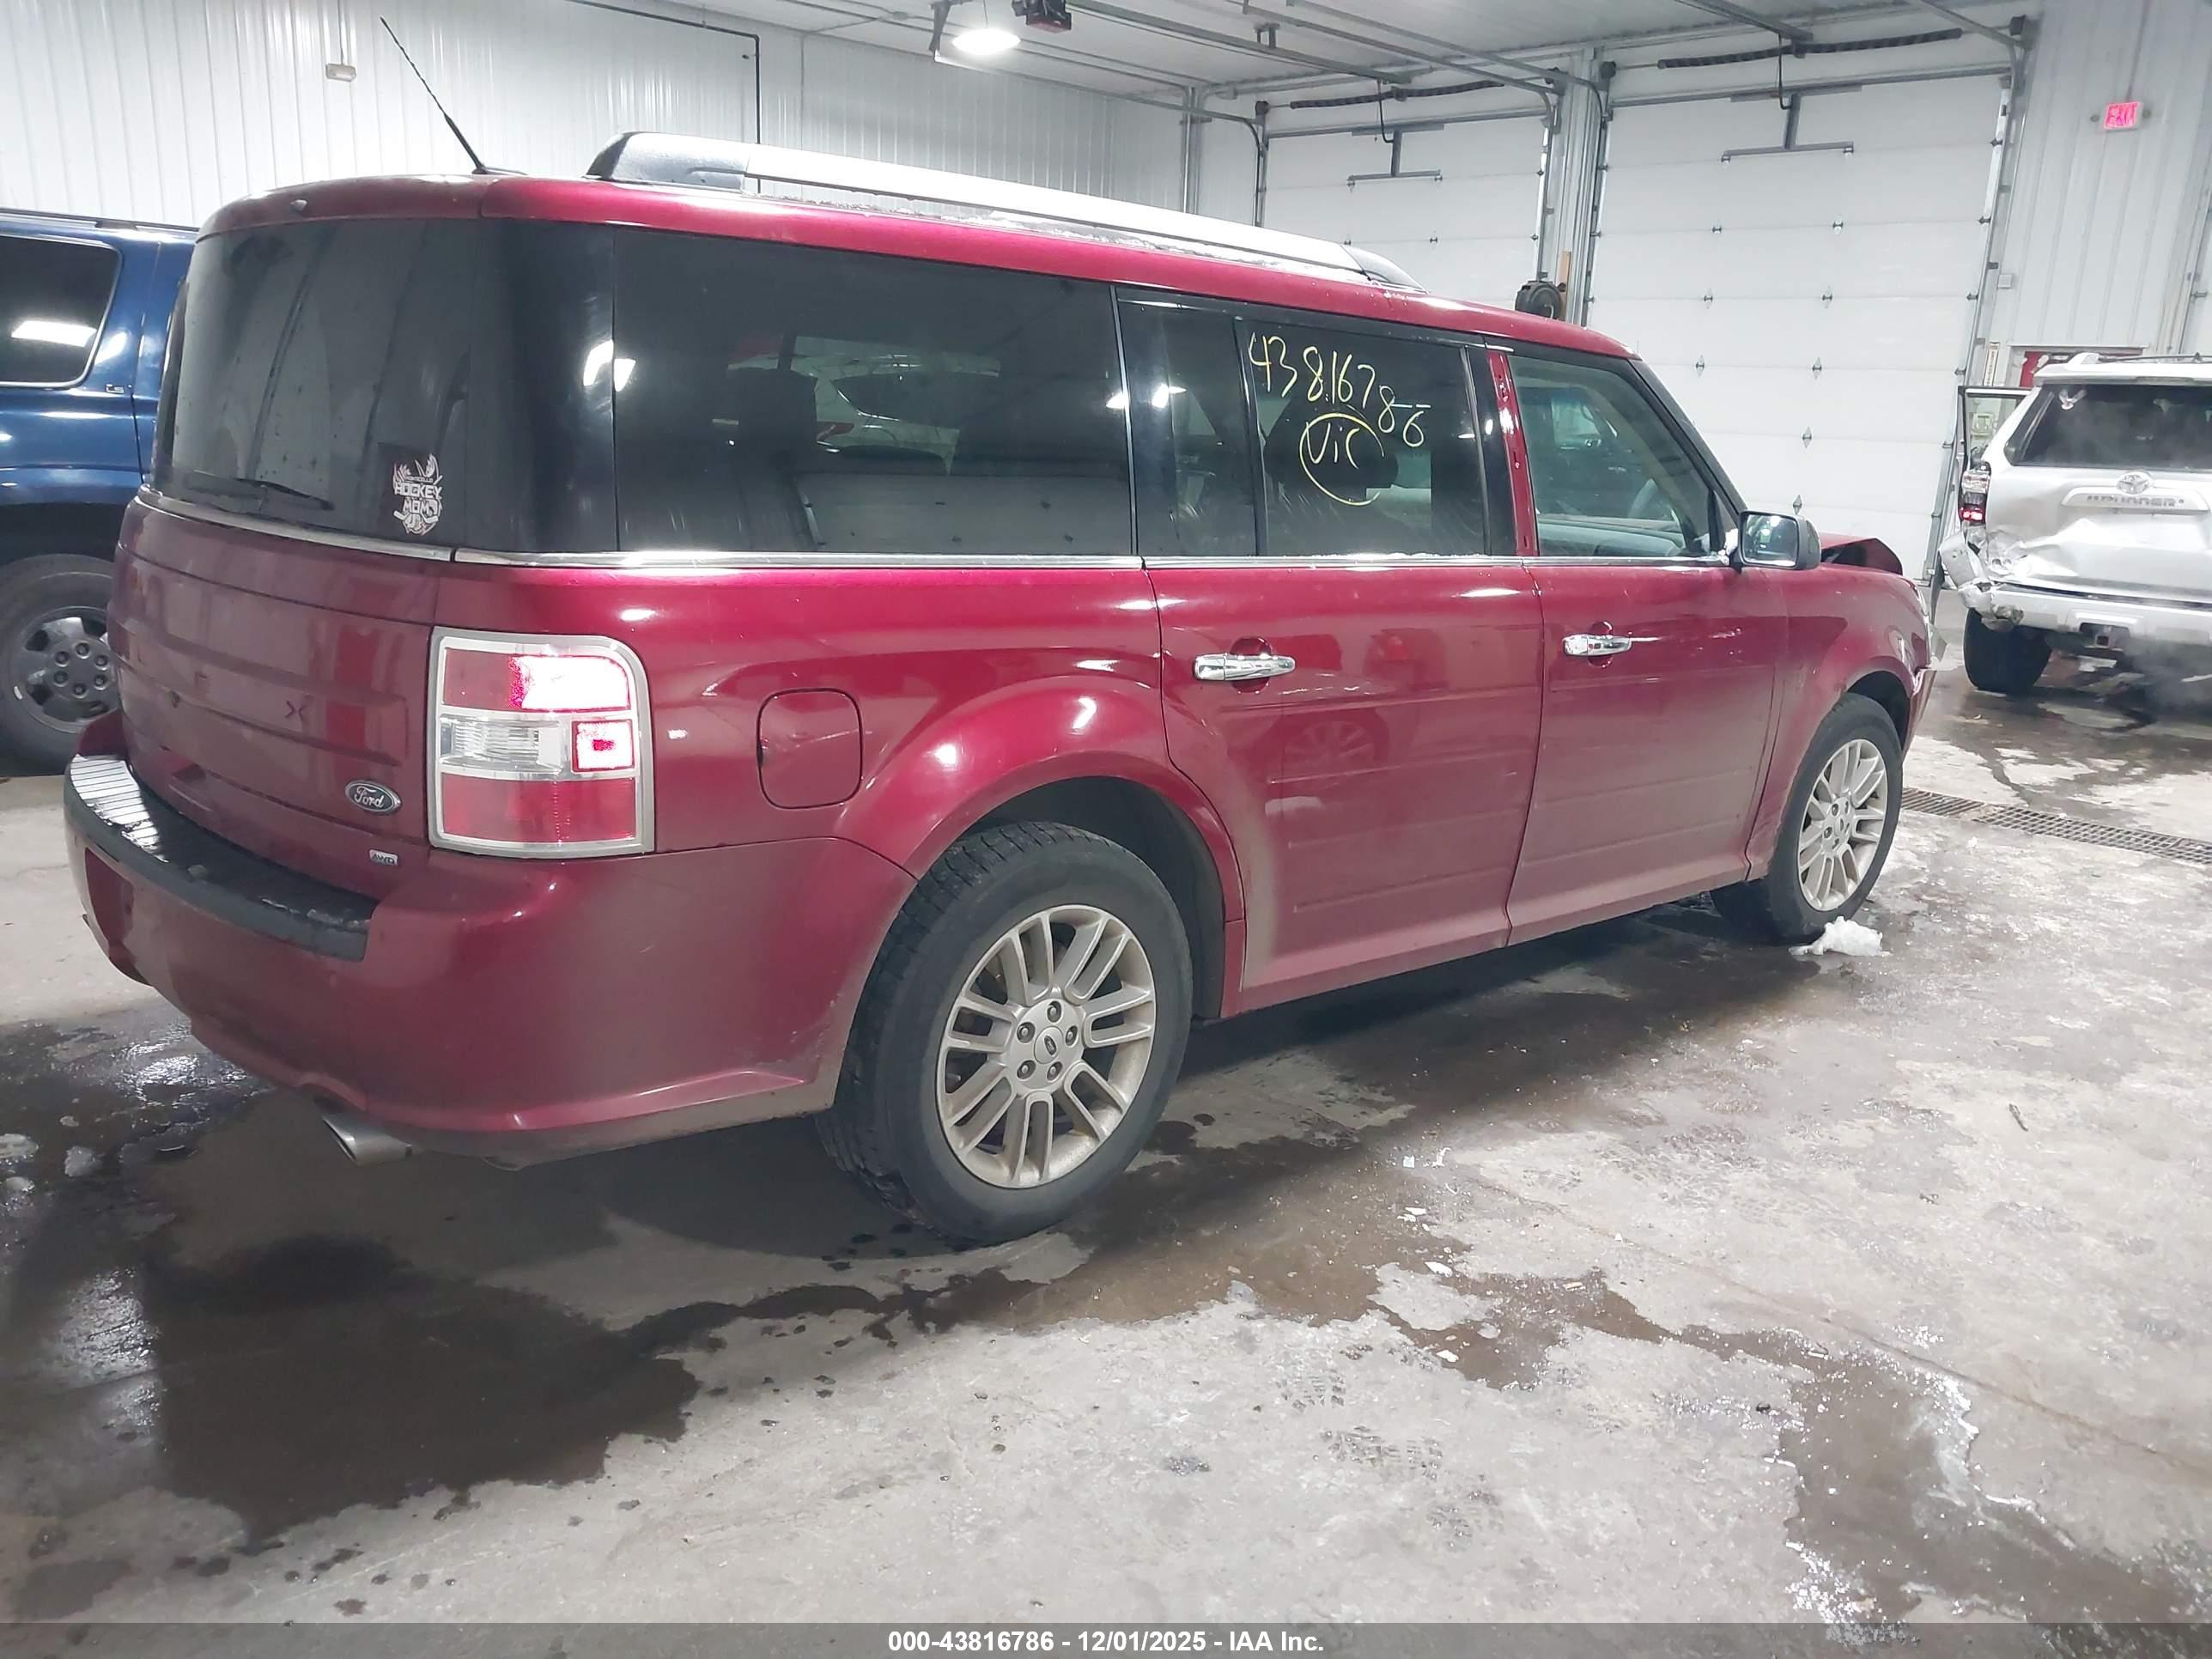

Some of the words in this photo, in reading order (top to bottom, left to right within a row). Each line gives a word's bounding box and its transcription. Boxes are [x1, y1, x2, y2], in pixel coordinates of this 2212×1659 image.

[1249, 332, 1431, 447] 43816786
[394, 482, 442, 499] HOCKEY
[354, 786, 386, 808] Ford
[370, 852, 396, 865] AWD
